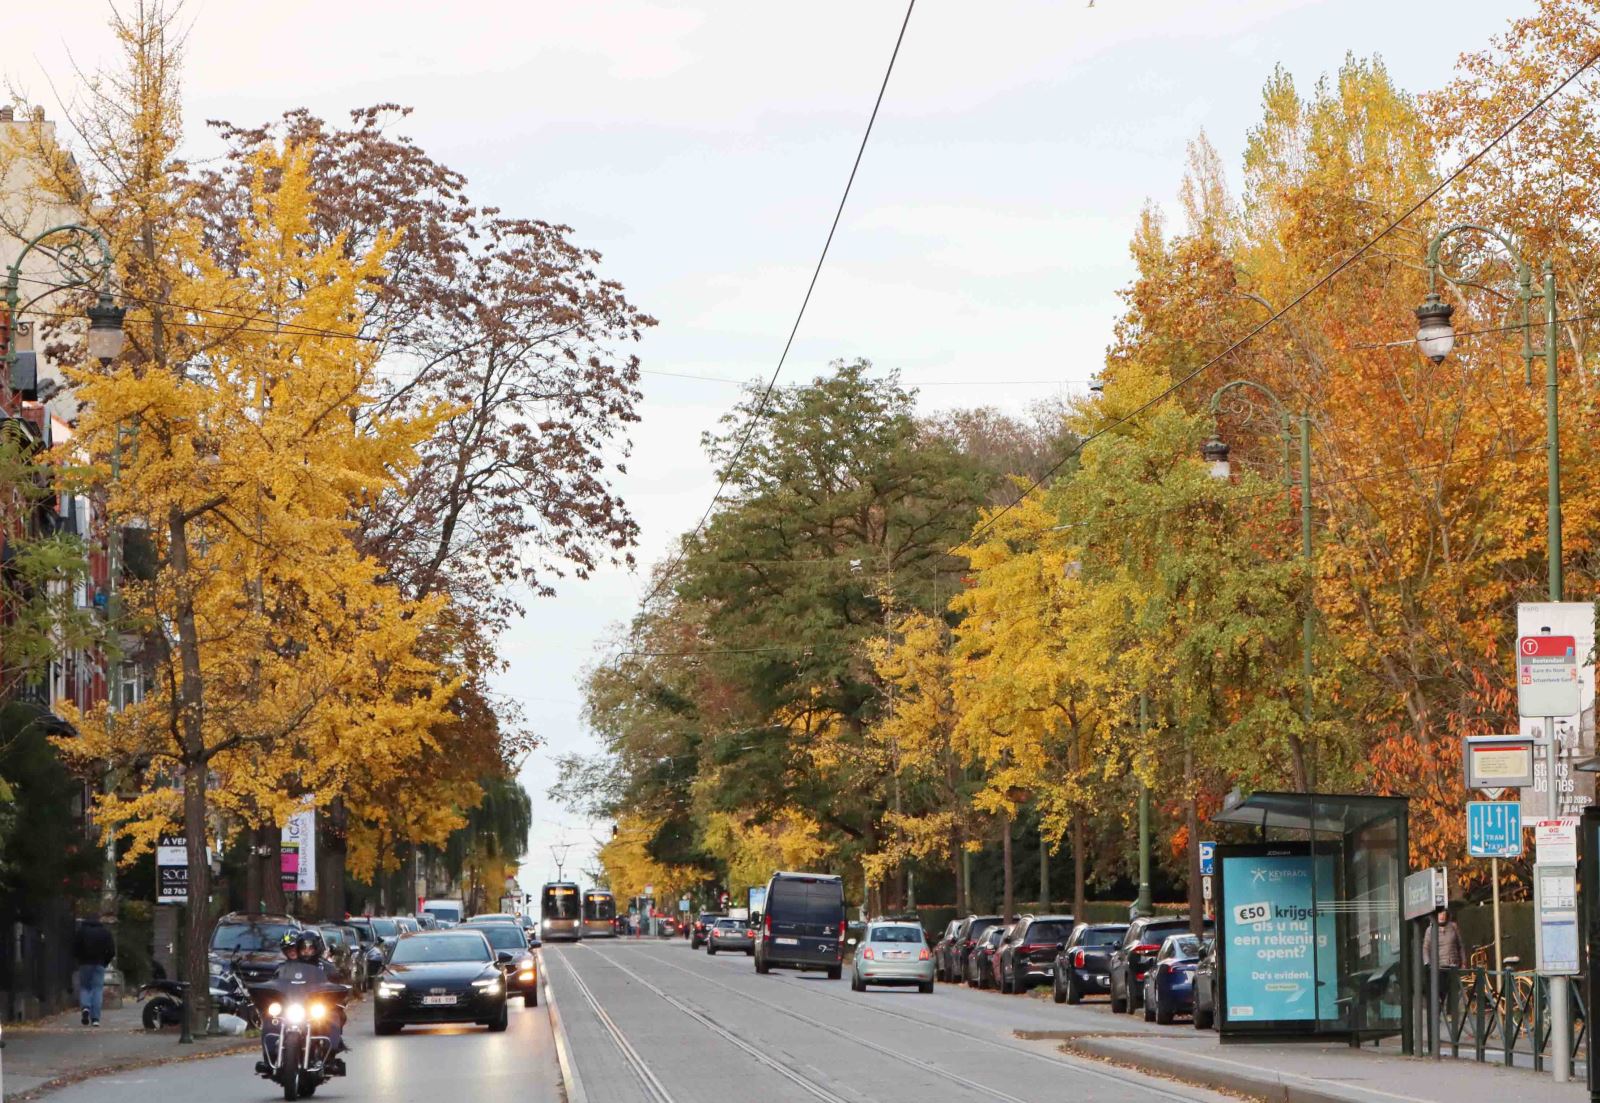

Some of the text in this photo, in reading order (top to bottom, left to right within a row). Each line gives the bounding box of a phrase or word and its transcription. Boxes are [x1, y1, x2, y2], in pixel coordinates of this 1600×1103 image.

[163, 837, 187, 845] A VEN
[1199, 844, 1213, 870] P
[163, 869, 187, 880] SOGE
[1240, 906, 1265, 919] €50
[1253, 921, 1308, 931] als u nu
[1234, 936, 1260, 945] een
[1257, 945, 1307, 961] opent?
